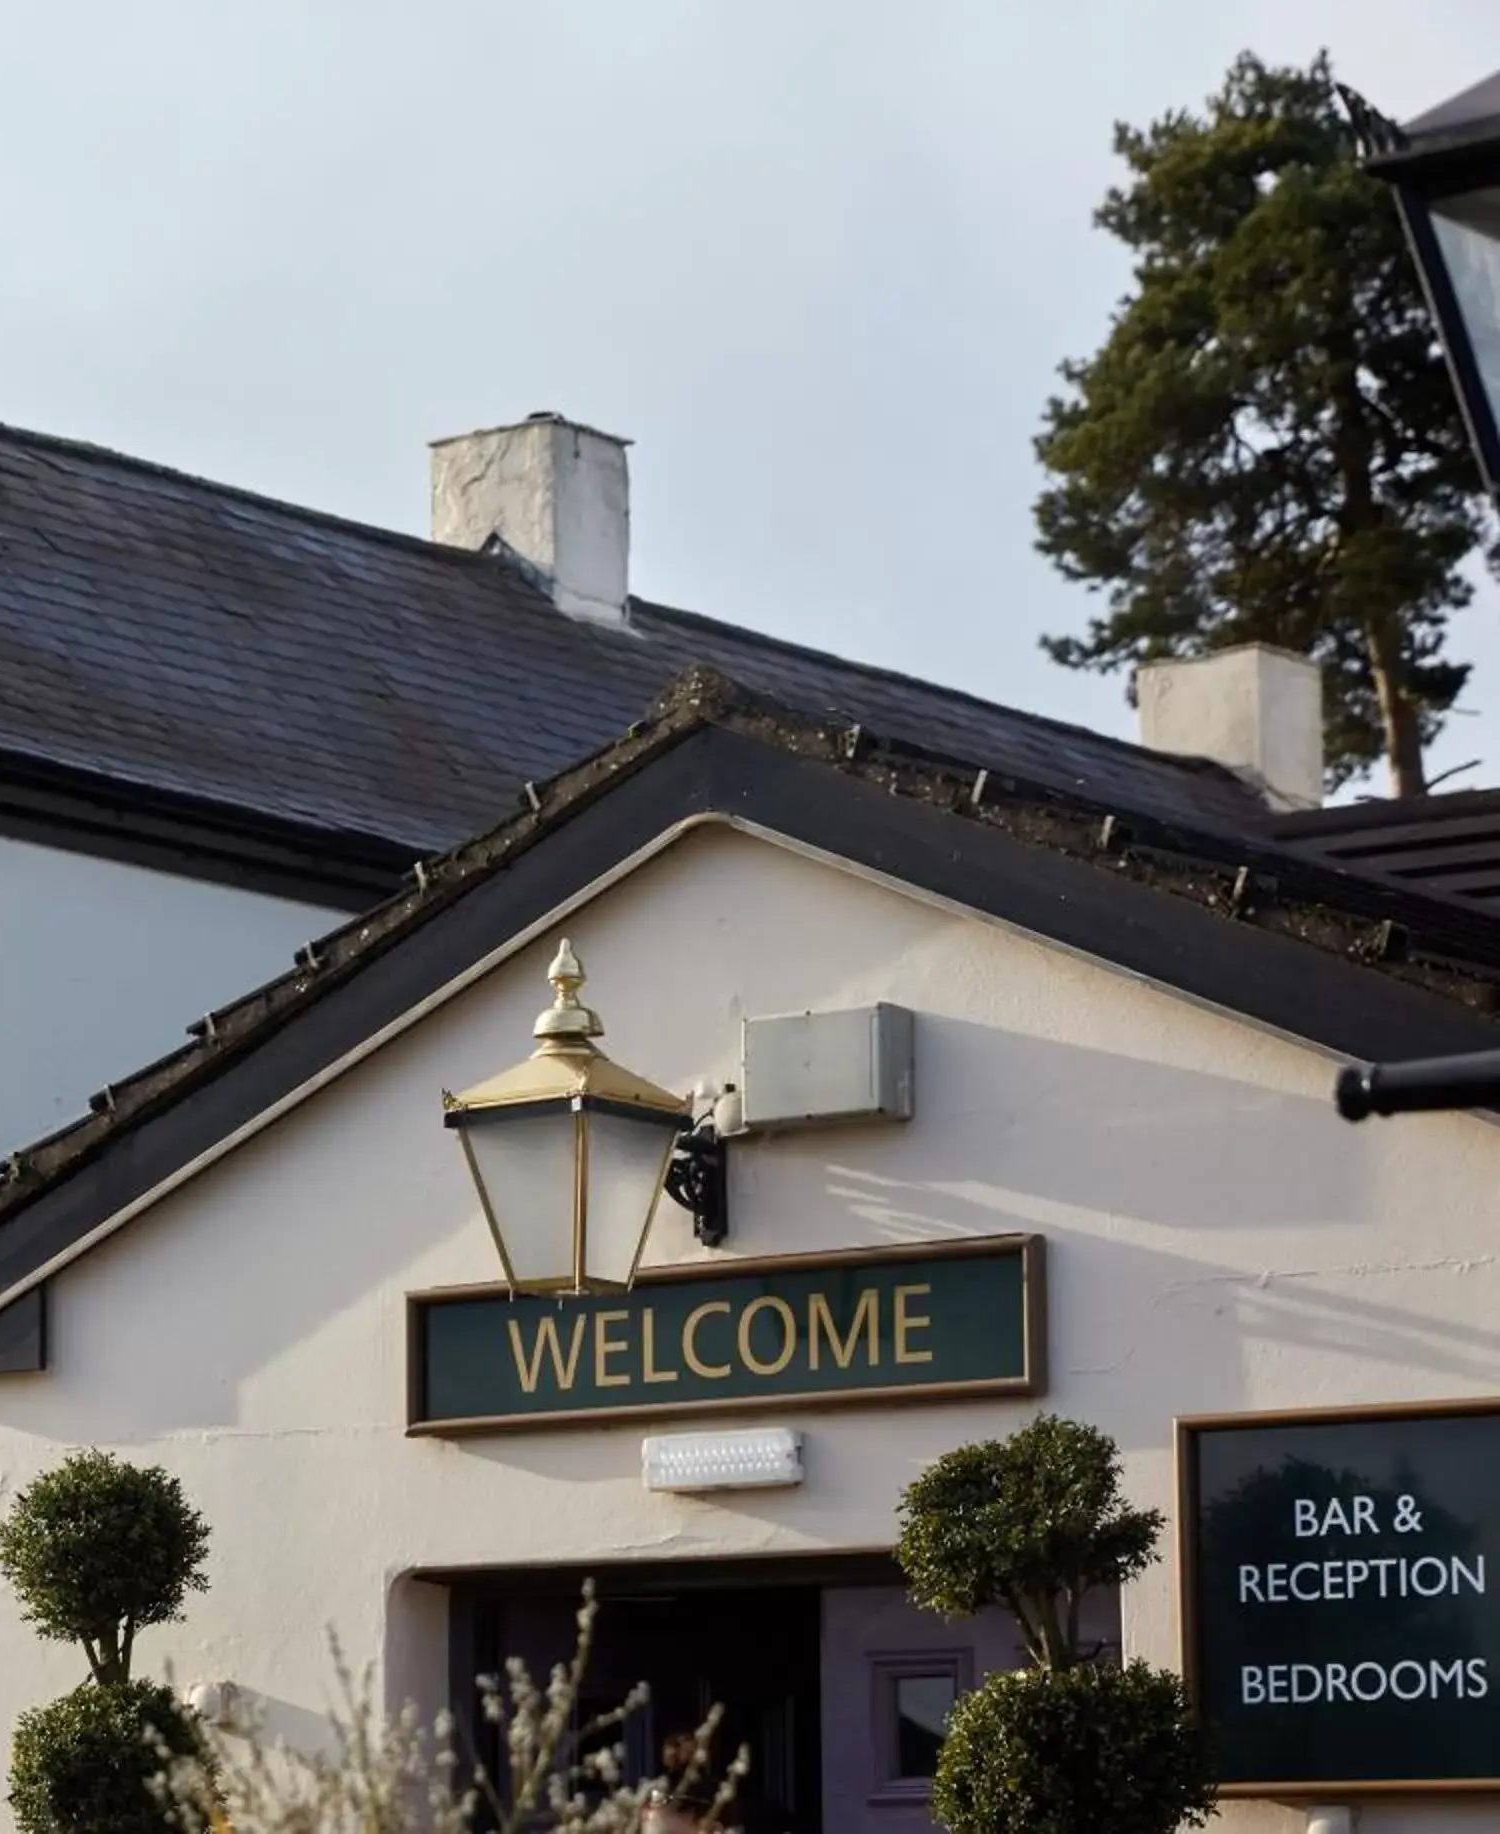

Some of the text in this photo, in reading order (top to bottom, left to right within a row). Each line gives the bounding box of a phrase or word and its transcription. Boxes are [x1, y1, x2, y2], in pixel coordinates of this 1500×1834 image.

[508, 1284, 933, 1393] WELCOME
[1294, 1493, 1423, 1537] BAR &
[1239, 1554, 1486, 1603] RECEPTION
[1241, 1658, 1489, 1704] BEDROOMS
